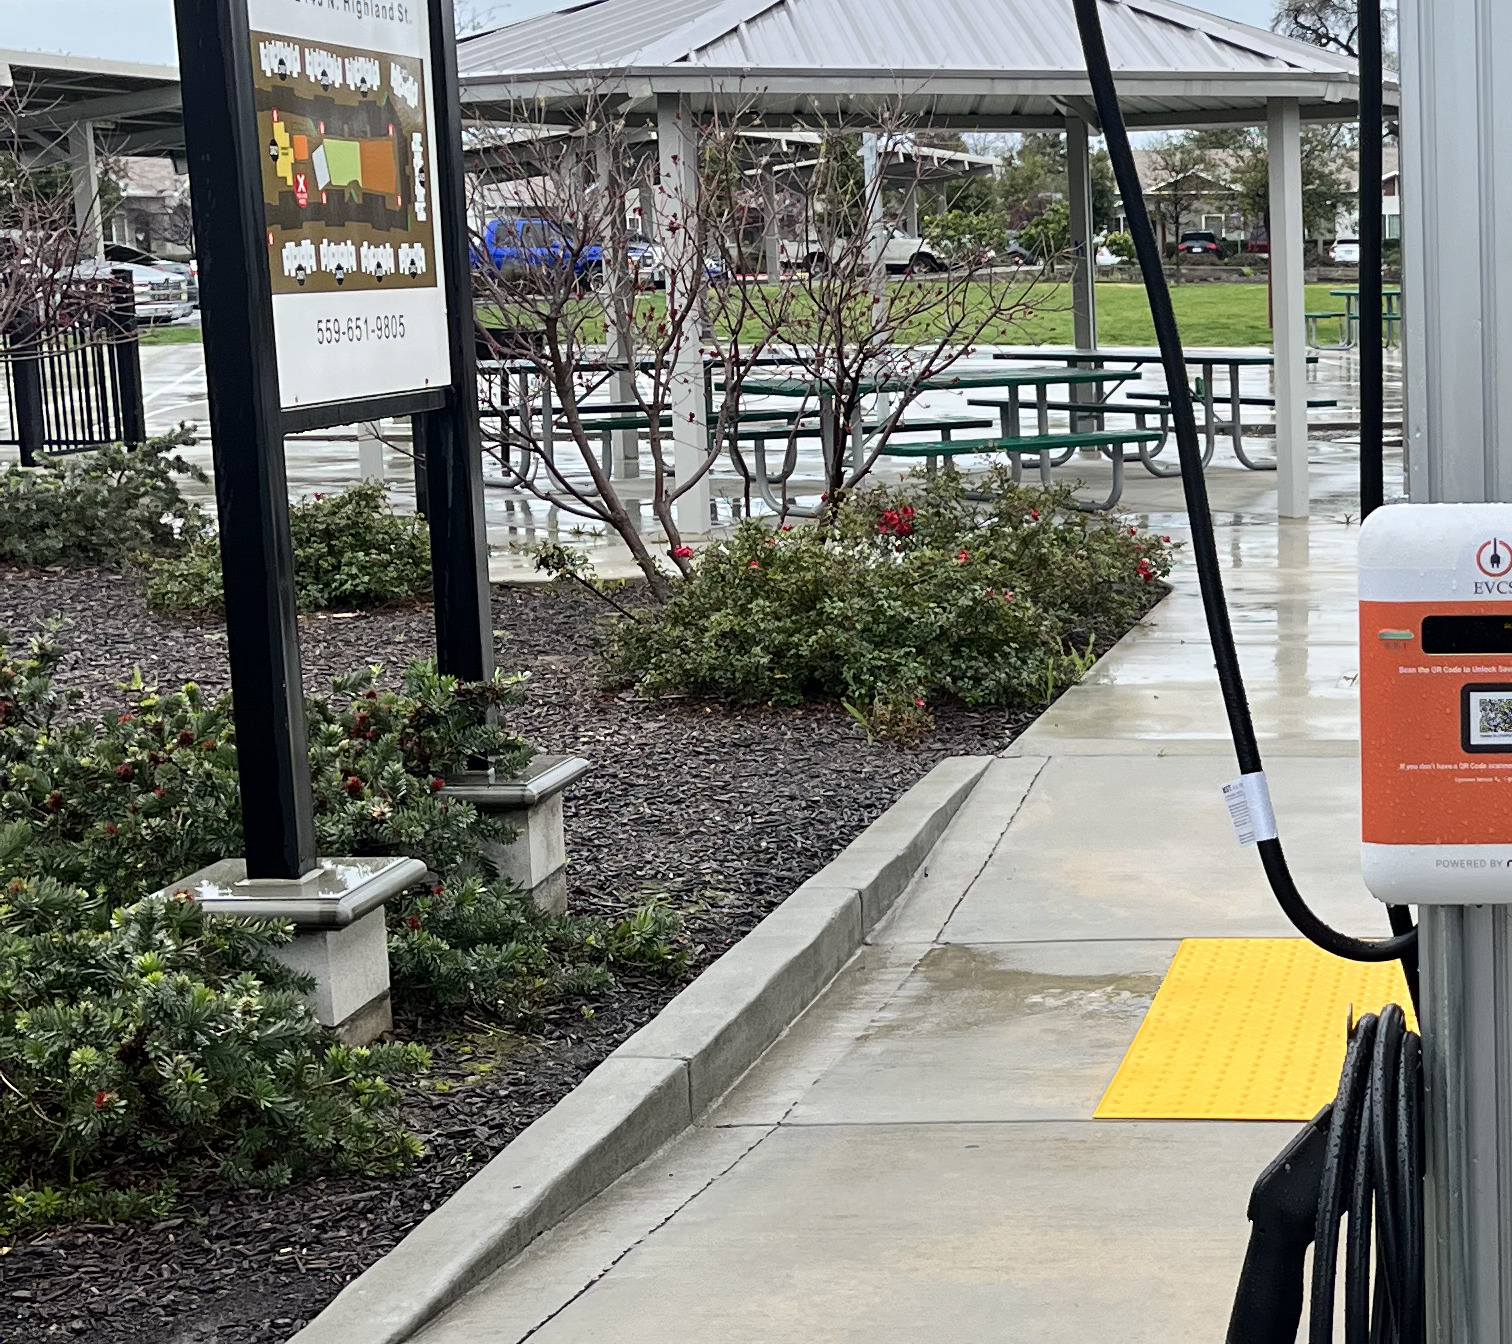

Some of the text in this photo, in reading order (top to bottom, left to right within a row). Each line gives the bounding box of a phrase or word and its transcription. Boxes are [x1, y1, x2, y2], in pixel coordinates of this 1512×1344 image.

[397, 3, 413, 25] St.
[316, 314, 406, 345] 559-651-9805
[1399, 666, 1417, 674] Scan
[1431, 665, 1442, 674] QR
[1443, 665, 1462, 674] Code
[1472, 665, 1497, 673] Unlock
[1436, 859, 1487, 869] POWERED
[1490, 859, 1503, 869] BY
